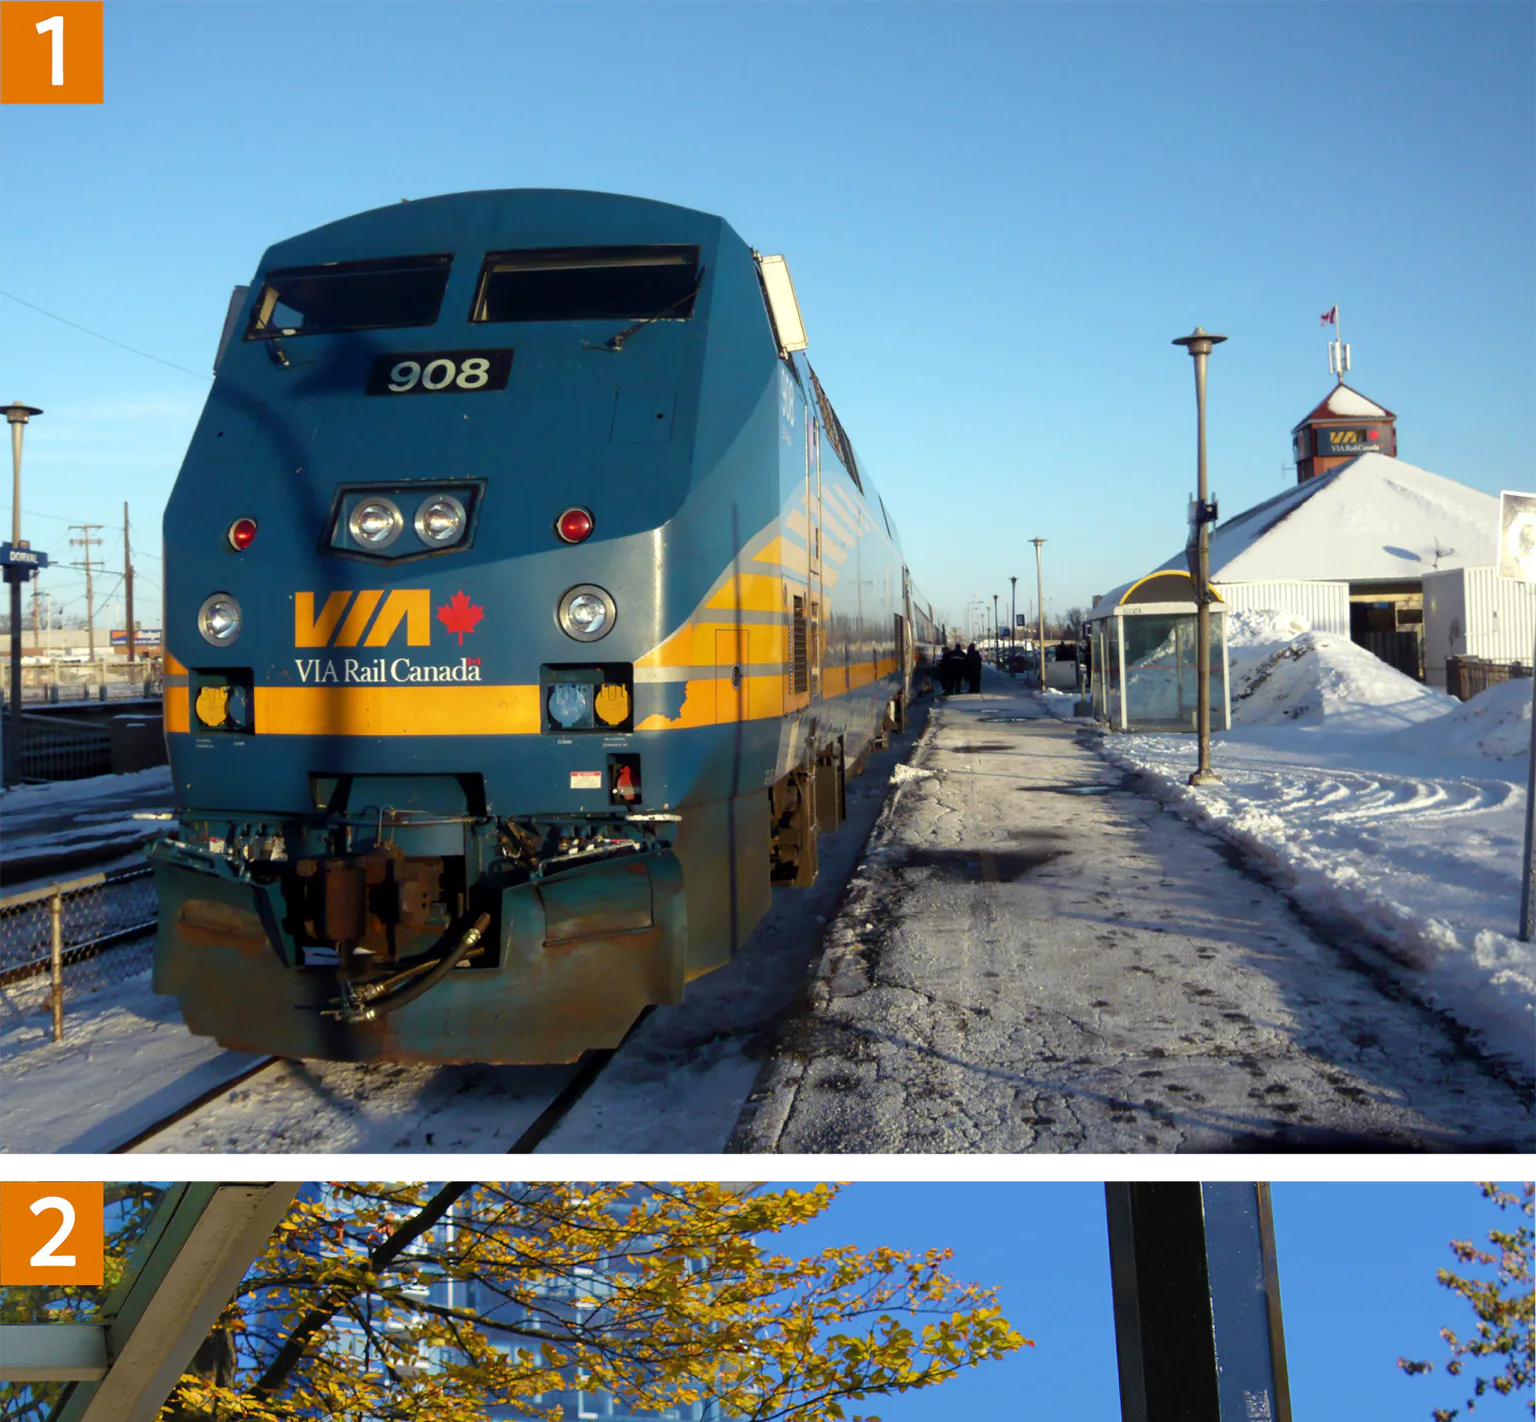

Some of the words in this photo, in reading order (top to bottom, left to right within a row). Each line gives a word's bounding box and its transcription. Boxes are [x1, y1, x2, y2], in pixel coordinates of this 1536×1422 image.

[388, 358, 490, 392] 908
[9, 550, 39, 564] DORVAL
[294, 588, 431, 648] VIA
[294, 659, 341, 683] VIA
[344, 658, 387, 683] Rail
[390, 657, 482, 683] Canada
